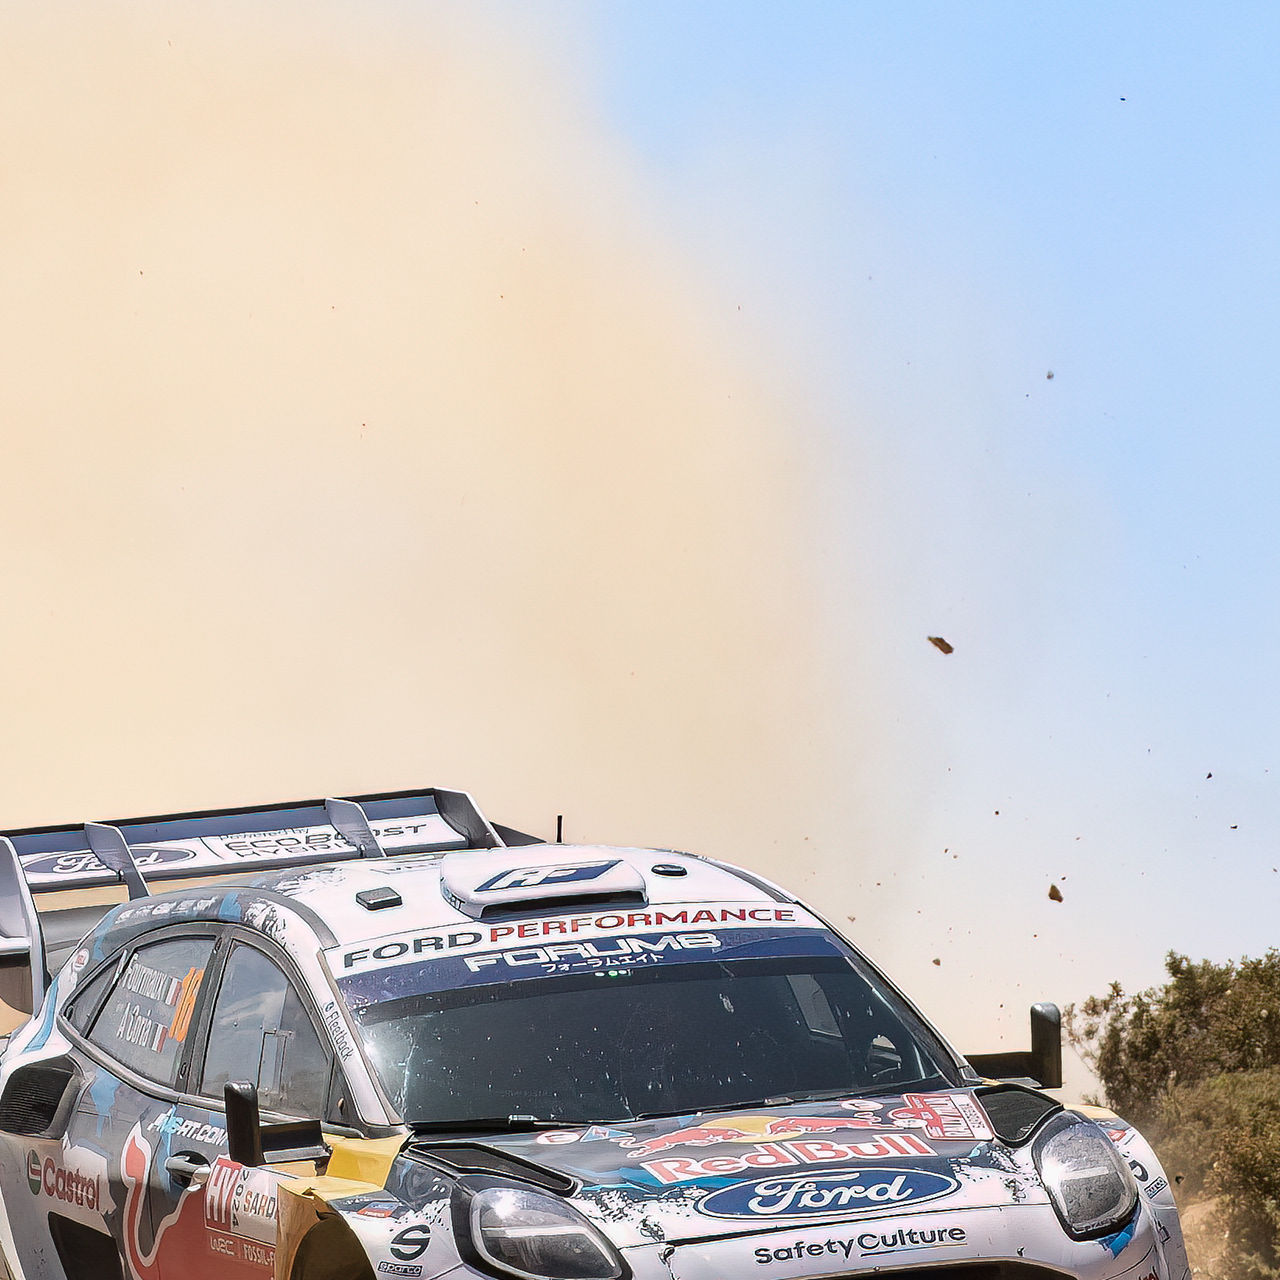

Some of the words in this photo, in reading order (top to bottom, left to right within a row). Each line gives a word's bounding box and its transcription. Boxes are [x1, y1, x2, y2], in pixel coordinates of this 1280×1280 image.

[52, 849, 164, 873] Fod
[344, 931, 483, 969] FORD
[489, 907, 797, 943] PERFORMANCE
[463, 933, 723, 973] FORUM8
[326, 1010, 354, 1062] Fleetback
[642, 1142, 799, 1184] Red
[791, 1134, 938, 1164] Bull
[42, 1157, 101, 1212] Castrol
[748, 1172, 916, 1214] Ford
